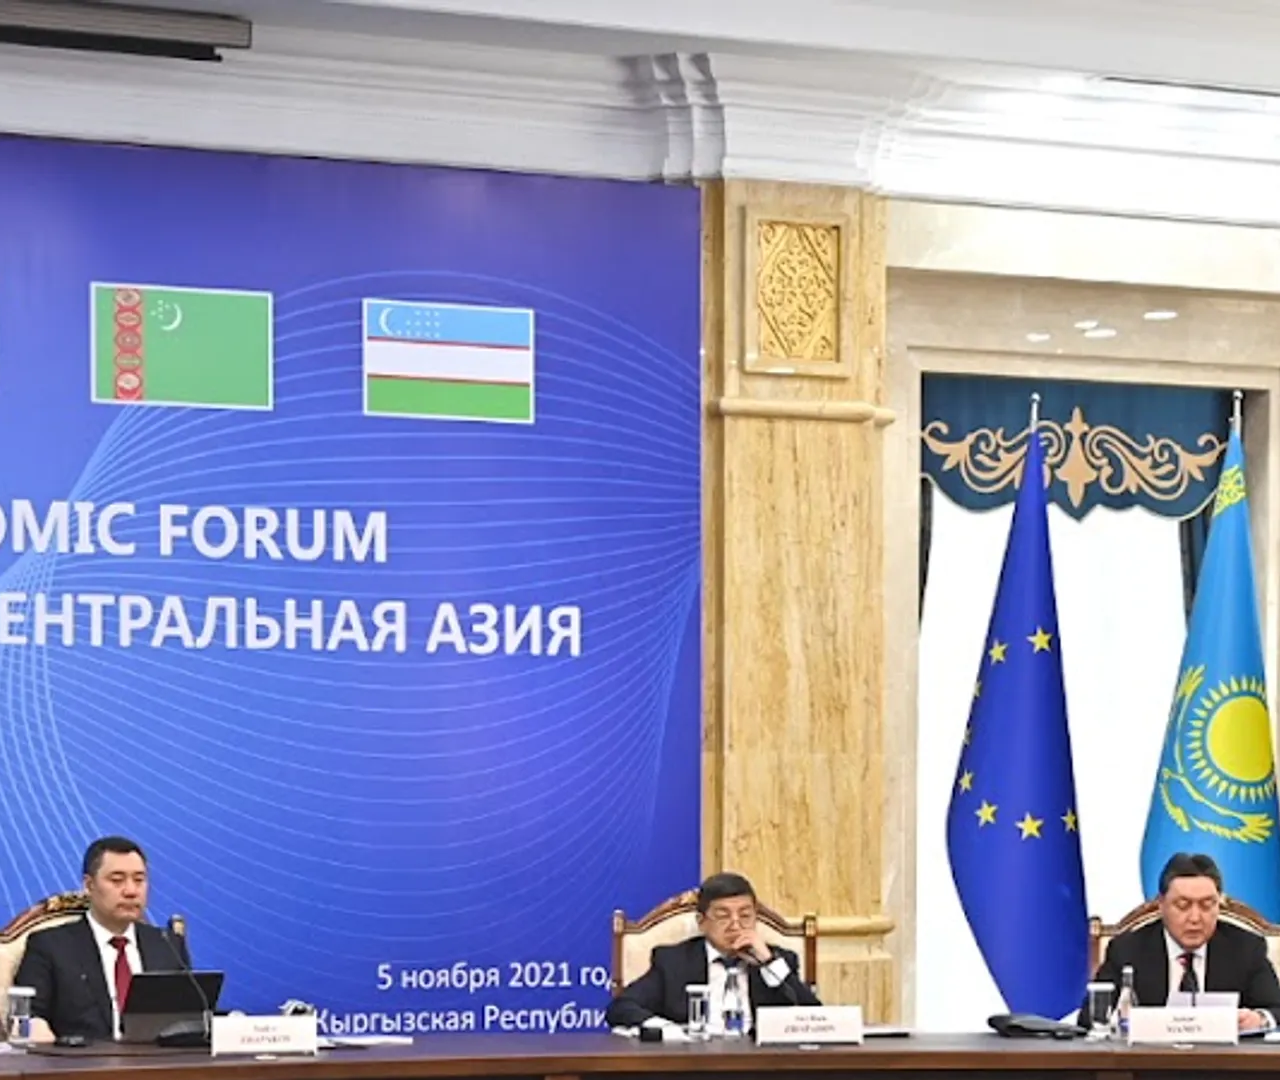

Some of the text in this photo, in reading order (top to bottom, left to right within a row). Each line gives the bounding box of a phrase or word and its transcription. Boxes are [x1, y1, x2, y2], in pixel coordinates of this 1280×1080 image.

[159, 503, 388, 563] FORUM
[426, 602, 583, 658] АЗИЯ
[377, 964, 392, 990] 5
[402, 962, 500, 993] ноября
[508, 962, 572, 988] 2021
[315, 1009, 475, 1034] Кыргызская
